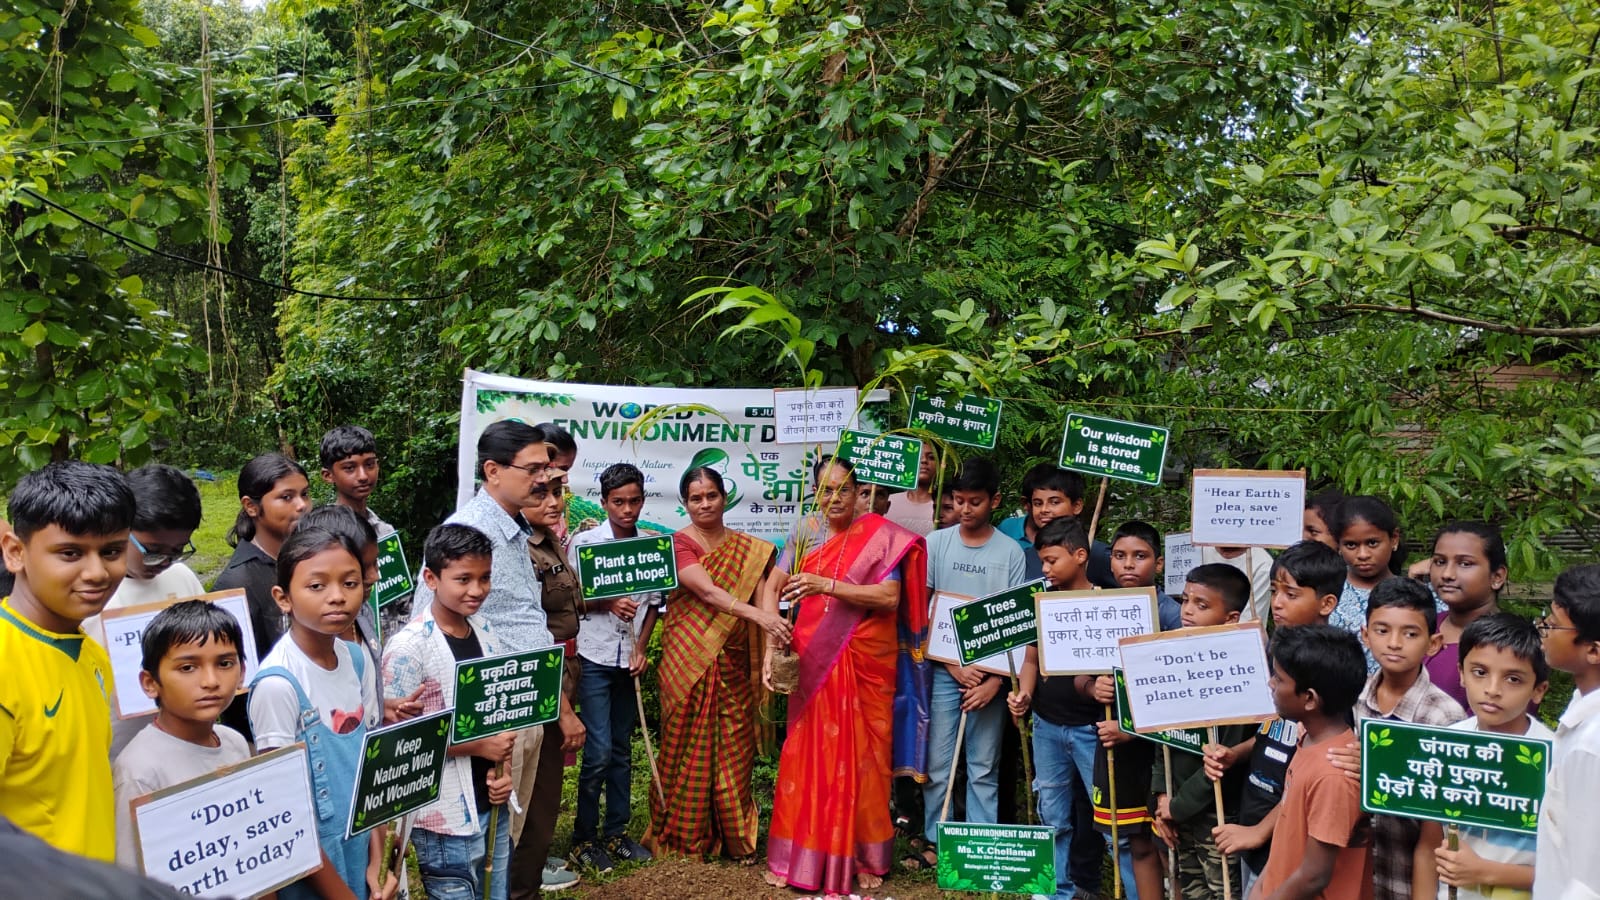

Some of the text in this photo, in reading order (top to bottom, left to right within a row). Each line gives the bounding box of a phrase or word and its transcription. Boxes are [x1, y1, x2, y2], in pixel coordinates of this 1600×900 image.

[815, 401, 826, 409] का
[829, 398, 844, 409] करो
[954, 400, 963, 412] से
[965, 404, 987, 417] प्यार,
[820, 411, 834, 421] यही
[836, 410, 842, 420] है
[918, 411, 945, 424] प्रकृति
[947, 416, 960, 426] का
[784, 425, 805, 434] जीवन
[1080, 426, 1152, 448] Our wisdom
[852, 445, 904, 462] यही पुकार,
[889, 440, 904, 450] की
[1087, 440, 1140, 460] is stored
[640, 460, 674, 469] Nature.
[760, 452, 779, 460] एक
[1075, 452, 1144, 474] in the trees.
[874, 471, 900, 482] प्यार।
[896, 463, 905, 472] से
[763, 469, 809, 502] माँ
[1204, 487, 1241, 497] “Hear
[750, 502, 764, 514] के
[768, 505, 796, 514] नाम
[1215, 502, 1278, 513] plea, save
[1210, 516, 1282, 528] every tree”
[594, 552, 664, 569] Plant a tree,
[952, 562, 986, 575] DREAM
[593, 564, 669, 589] plant a hope!
[983, 598, 1017, 617] Trees
[1085, 606, 1099, 621] माँ
[1101, 606, 1118, 620] की
[1120, 605, 1142, 621] यही
[972, 608, 1034, 635] are treasure,
[115, 630, 142, 646] “Pl
[963, 619, 1037, 650] beyond measur
[1047, 623, 1144, 644] पुकार, पेड़ लगाओ
[1154, 649, 1228, 666] “Don't be
[480, 659, 540, 682] प्रकृति का
[1135, 664, 1256, 687] mean, keep the
[484, 676, 535, 696] सम्मान,
[1145, 680, 1251, 705] planet green”
[474, 690, 539, 712] यही है सच्चा
[482, 706, 533, 725] अभियान!
[394, 737, 422, 758] Keep
[1418, 737, 1504, 763] जंगल की
[373, 749, 435, 787] Nature Wild
[1406, 758, 1508, 789] यही पुकार,
[363, 770, 435, 812] Not Wounded
[1376, 773, 1539, 814] पेड़ों से करो प्यार।
[190, 787, 264, 826] “Don't
[168, 810, 292, 872] delay, save
[944, 827, 968, 836] WORLD
[970, 828, 1017, 838] ENVIRONMENT
[1018, 831, 1032, 839] DAY
[957, 845, 974, 854] Ms.
[179, 829, 304, 897] arth today”
